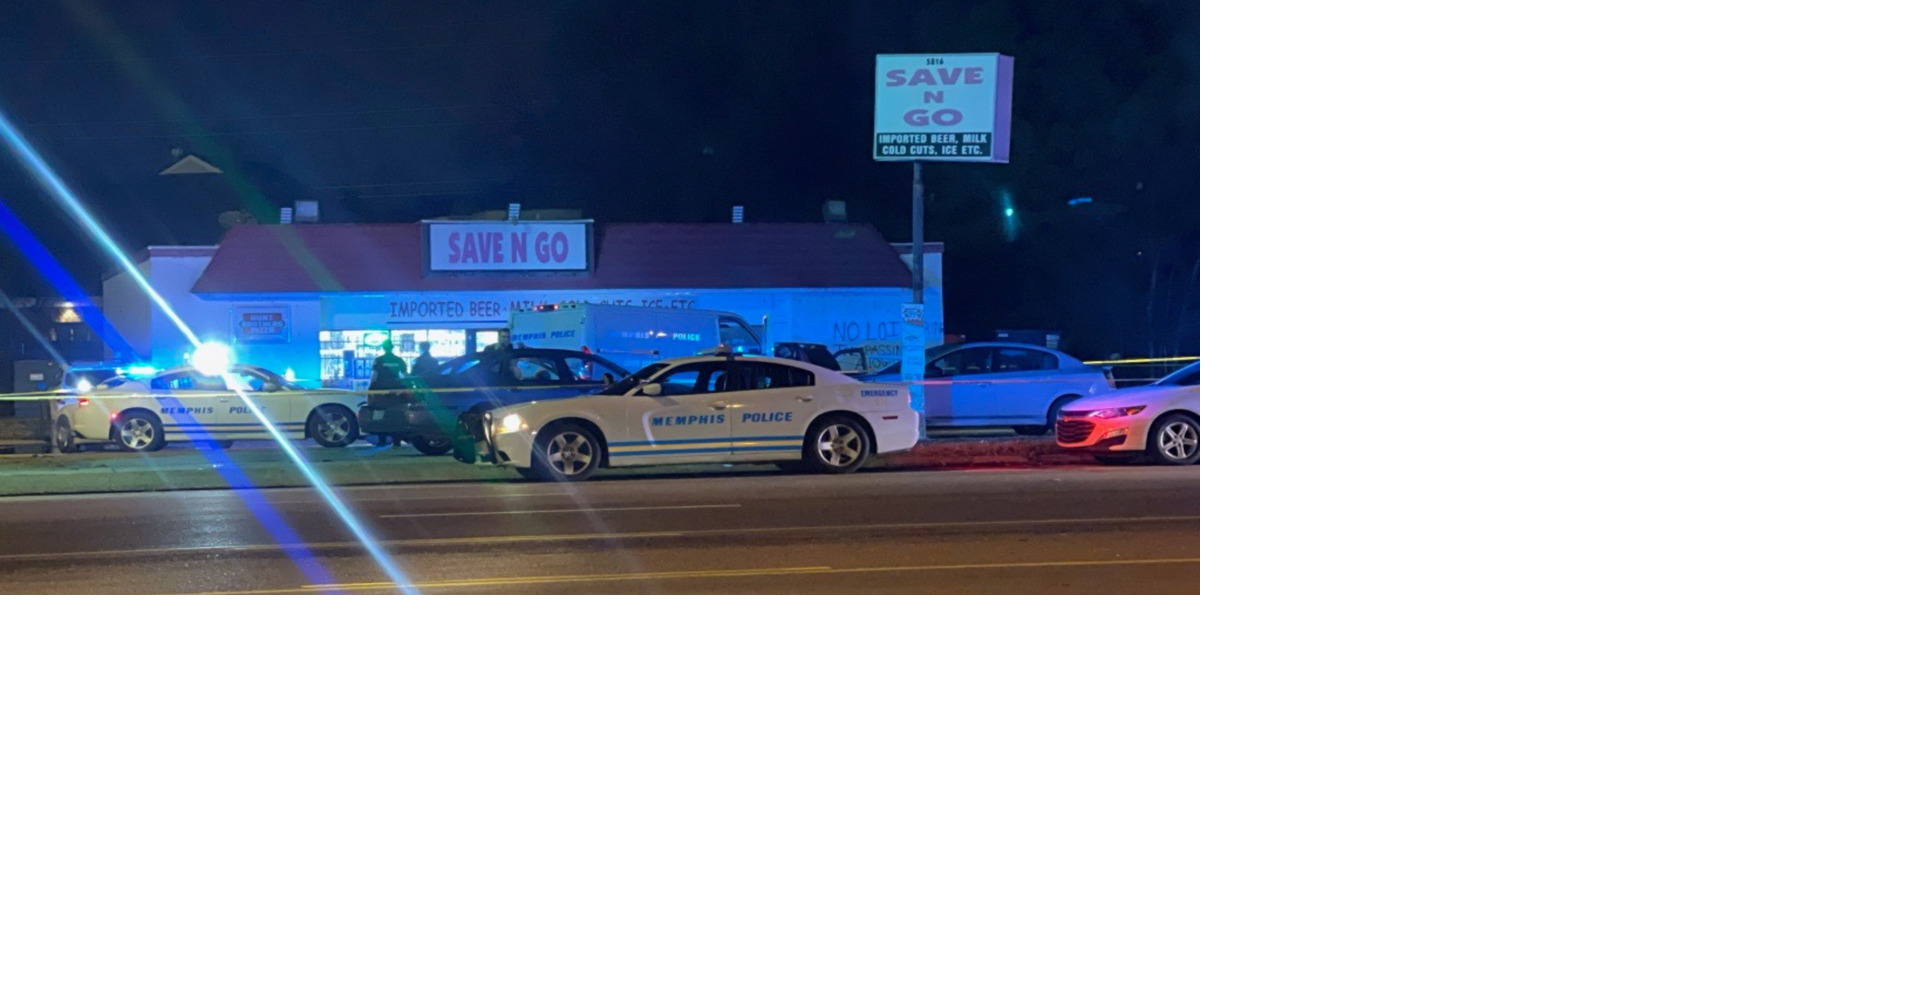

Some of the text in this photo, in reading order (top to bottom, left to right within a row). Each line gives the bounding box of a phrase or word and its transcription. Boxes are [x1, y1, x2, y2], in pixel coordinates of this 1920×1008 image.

[885, 67, 984, 87] SAVE
[923, 90, 944, 104] N
[903, 108, 963, 127] GO
[879, 133, 987, 145] IMPORTED BEER, MILK
[882, 145, 983, 156] COLD CUTS, ICE ETC.
[448, 231, 569, 264] SAVE N GO
[390, 301, 464, 318] IMPORTED
[551, 329, 576, 339] POLICE
[672, 333, 701, 341] POLICE
[834, 322, 860, 341] NO
[861, 389, 898, 398] EMERGENCY
[160, 406, 214, 415] MEMPHIS
[651, 411, 793, 427] MEMPHIS POLICE
